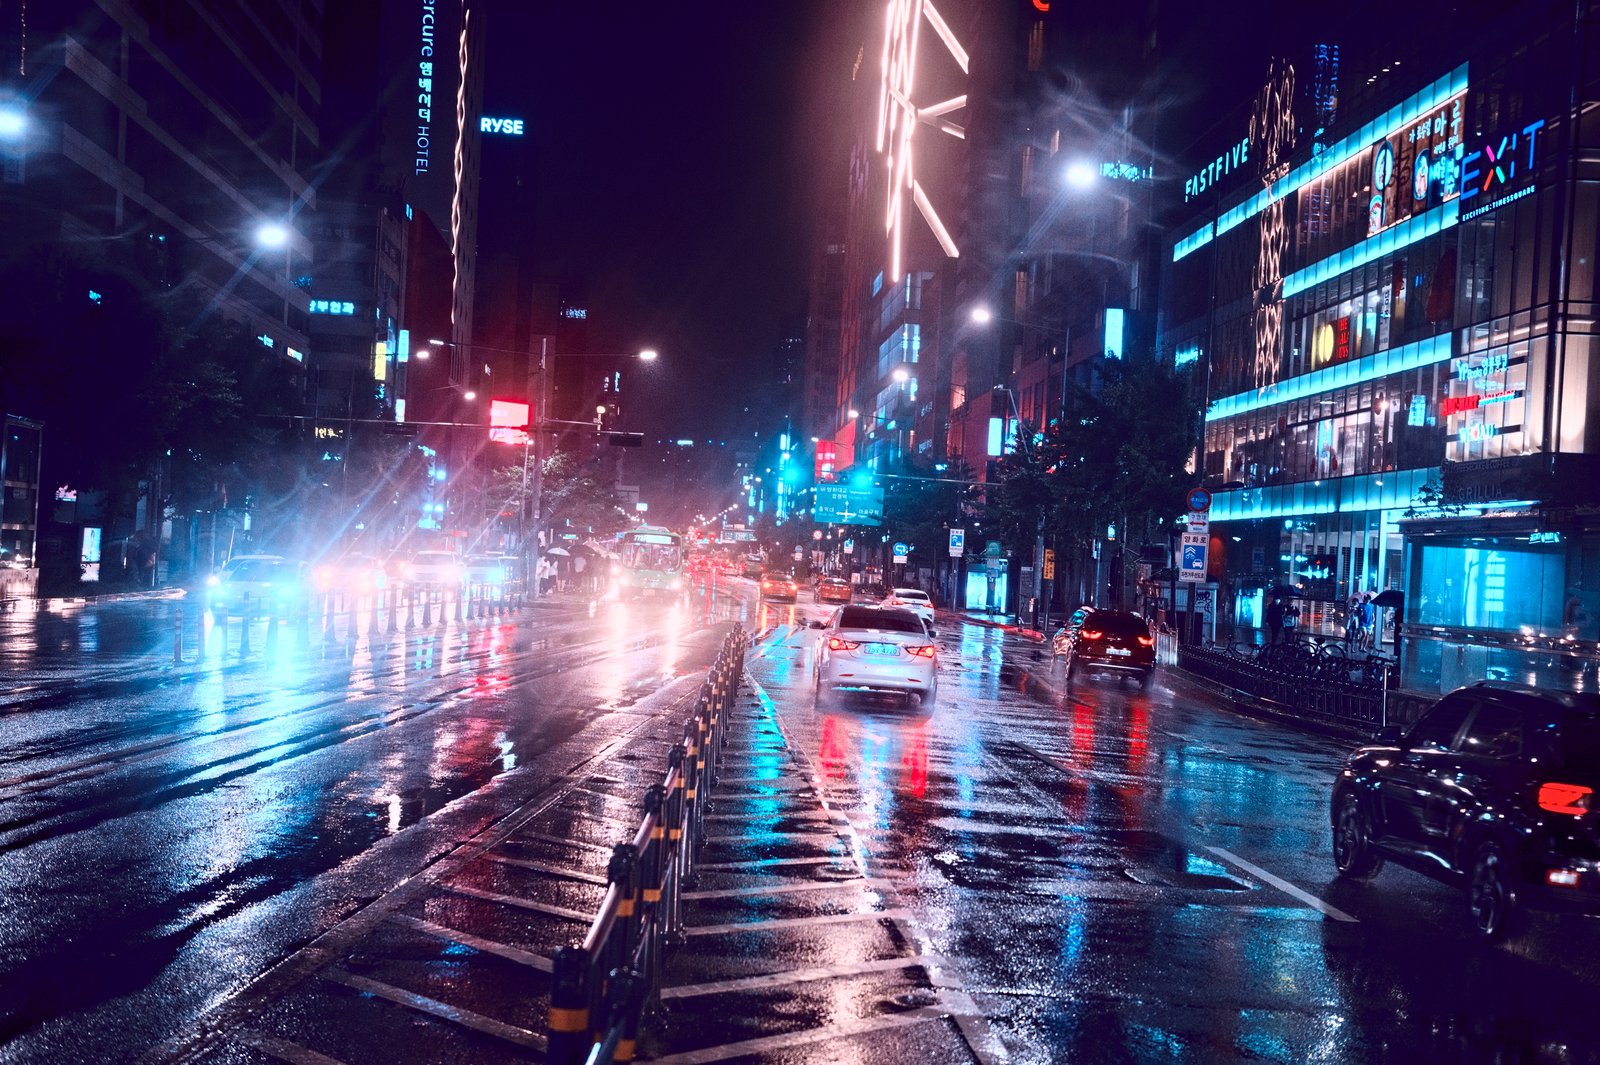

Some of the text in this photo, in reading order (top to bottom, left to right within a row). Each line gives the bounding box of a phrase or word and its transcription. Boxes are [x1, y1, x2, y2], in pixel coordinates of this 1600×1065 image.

[418, 61, 433, 123] 앰배서더
[415, 126, 430, 176] HOTEL
[480, 117, 524, 135] RYSE
[1184, 137, 1249, 203] FASTFIVE
[1460, 119, 1545, 201] EXIT
